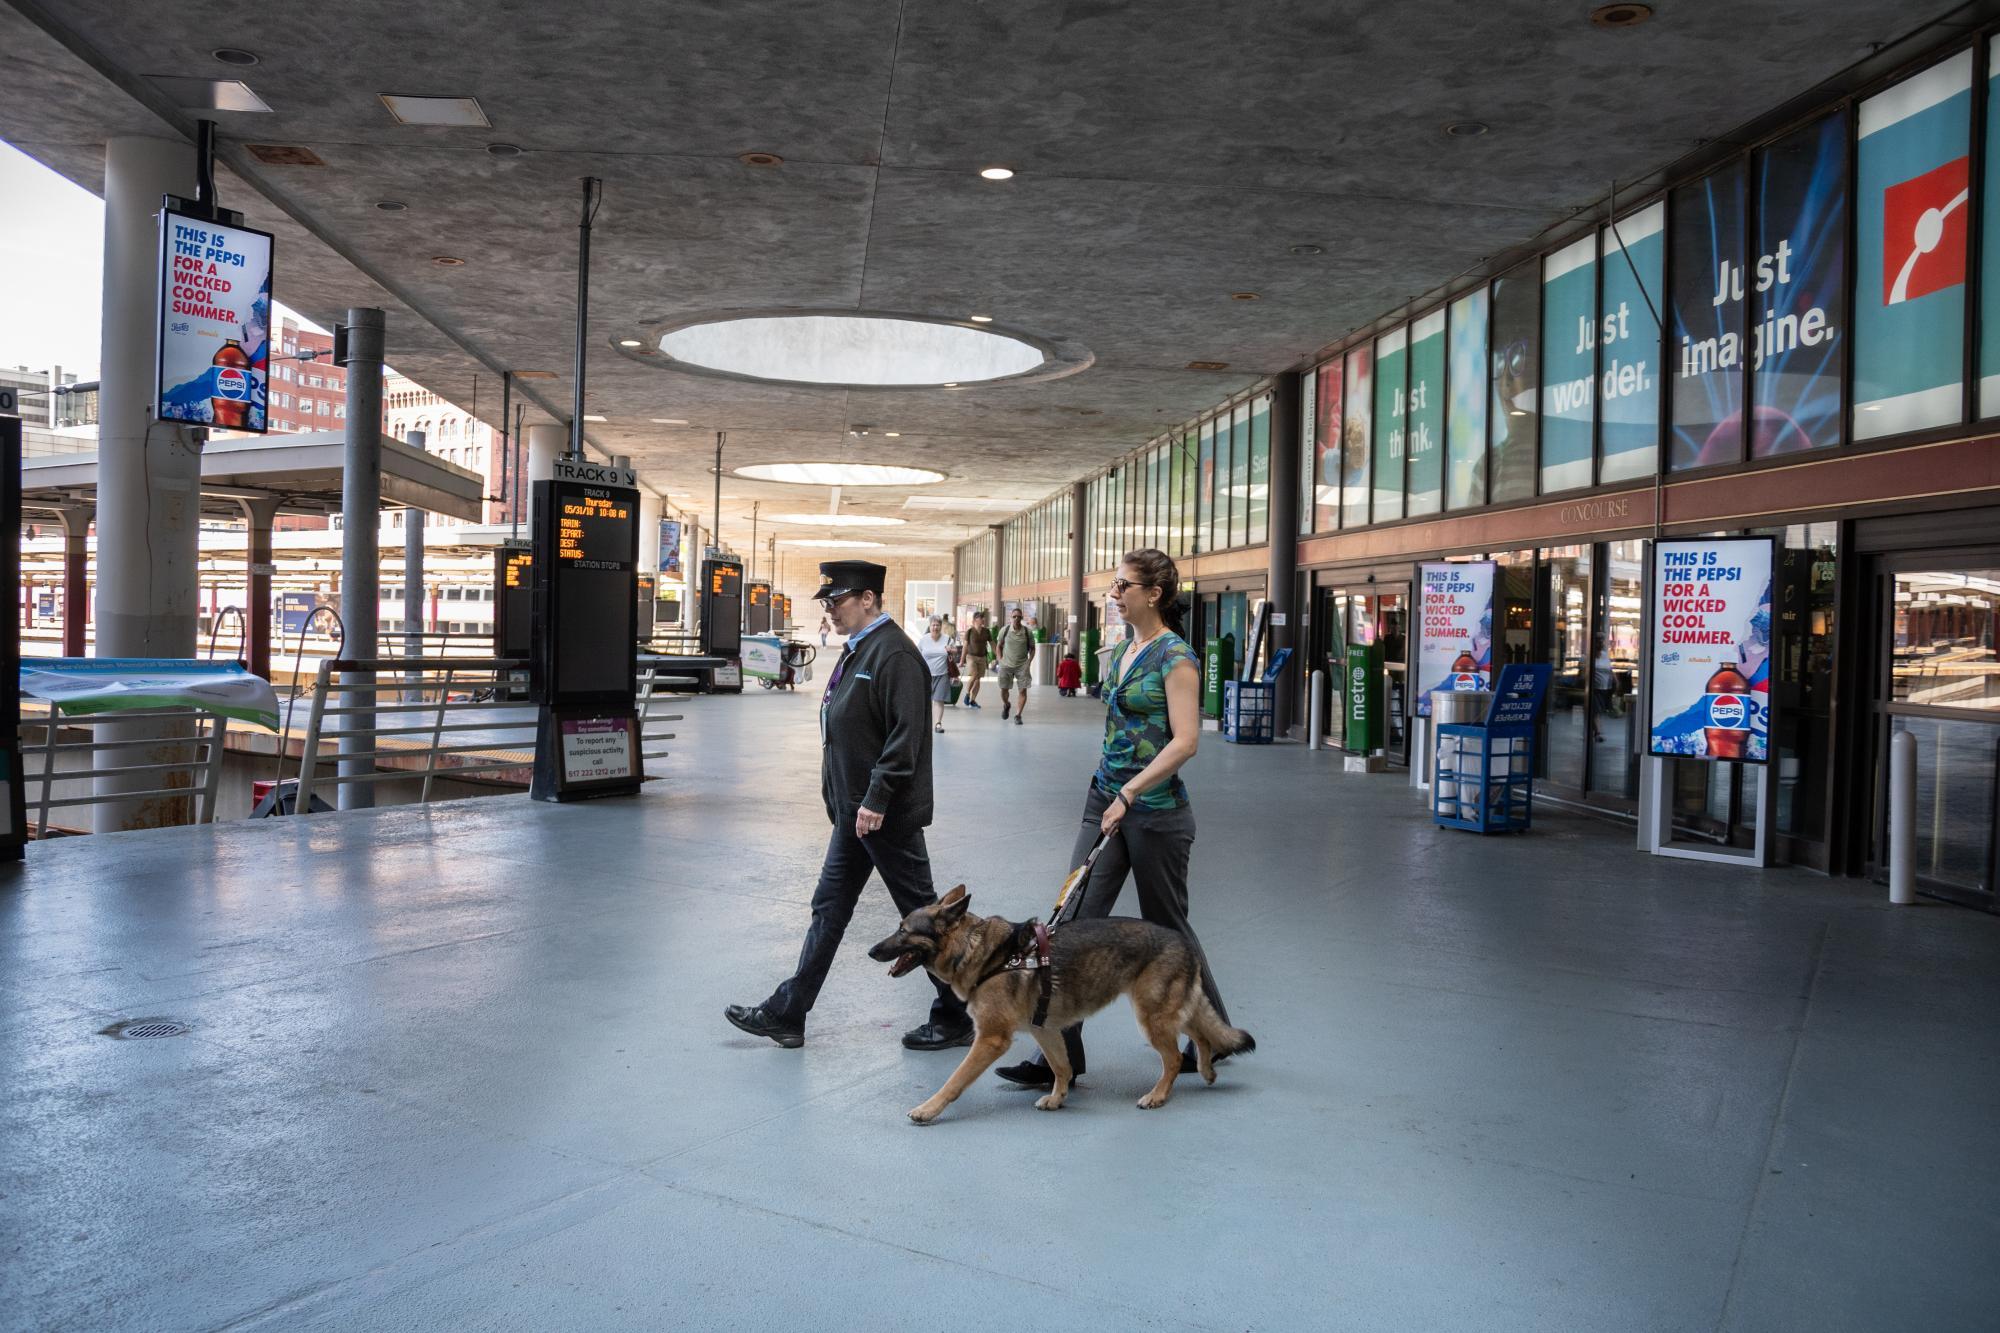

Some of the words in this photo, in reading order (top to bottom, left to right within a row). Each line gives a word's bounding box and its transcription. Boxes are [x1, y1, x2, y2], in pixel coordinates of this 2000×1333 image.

[175, 225, 207, 243] THIS
[211, 234, 225, 248] IS
[174, 241, 202, 257] THE
[205, 248, 245, 267] PEPSI
[173, 255, 204, 273] FOR
[207, 263, 218, 276] A
[1713, 239, 1792, 306] Just
[173, 270, 232, 293] WICKED
[172, 285, 213, 304] COOL
[172, 301, 239, 324] SUMMER.
[1576, 302, 1630, 355] Just
[1682, 307, 1834, 378] imagine.
[218, 378, 245, 389] PEPSI
[1392, 380, 1426, 417] Just
[1390, 422, 1433, 459] think.
[555, 464, 605, 482] TRACK
[609, 471, 618, 483] 9
[584, 488, 605, 497] TRACK
[605, 490, 610, 498] 9
[585, 498, 613, 507] Thursday
[565, 505, 594, 516] 05/31/18
[599, 508, 617, 518] 10:08
[618, 509, 627, 518] AM
[1561, 499, 1628, 524] CONCOURSE
[560, 518, 581, 527] TRAIN:
[560, 529, 584, 538] DEPART:
[560, 539, 578, 548] DEST:
[560, 549, 584, 558] STATUS:
[1664, 552, 1698, 566] THIS
[1702, 552, 1717, 565] IS
[574, 560, 600, 569] STATION
[601, 561, 620, 570] STOPS
[1426, 572, 1448, 581] THIS
[1451, 572, 1460, 581] IS
[1664, 568, 1692, 581] THE
[1696, 567, 1742, 581] PEPSI
[1425, 583, 1444, 593] THE
[1446, 583, 1474, 593] PEPSI
[1663, 584, 1695, 597] FOR
[1698, 584, 1710, 597] A
[1425, 594, 1445, 604] FOR
[1447, 594, 1455, 604] A
[1425, 606, 1465, 615] WICKED
[1663, 600, 1726, 613] WICKED
[1424, 617, 1453, 626] COOL
[1662, 615, 1705, 628] COOL
[1424, 628, 1470, 638] SUMMER.
[1662, 631, 1735, 644] SUMMER.
[1349, 649, 1364, 657] FREE
[1208, 653, 1219, 693] metro
[1513, 682, 1534, 690] PAPER
[1351, 666, 1365, 721] metro
[1500, 702, 1532, 710] RECYCLING
[1712, 707, 1743, 716] PEPSI
[1494, 713, 1532, 722] NEWSPAPER
[585, 737, 604, 745] report
[569, 748, 601, 756] suspicious
[602, 746, 624, 754] activity
[595, 768, 608, 776] 1212
